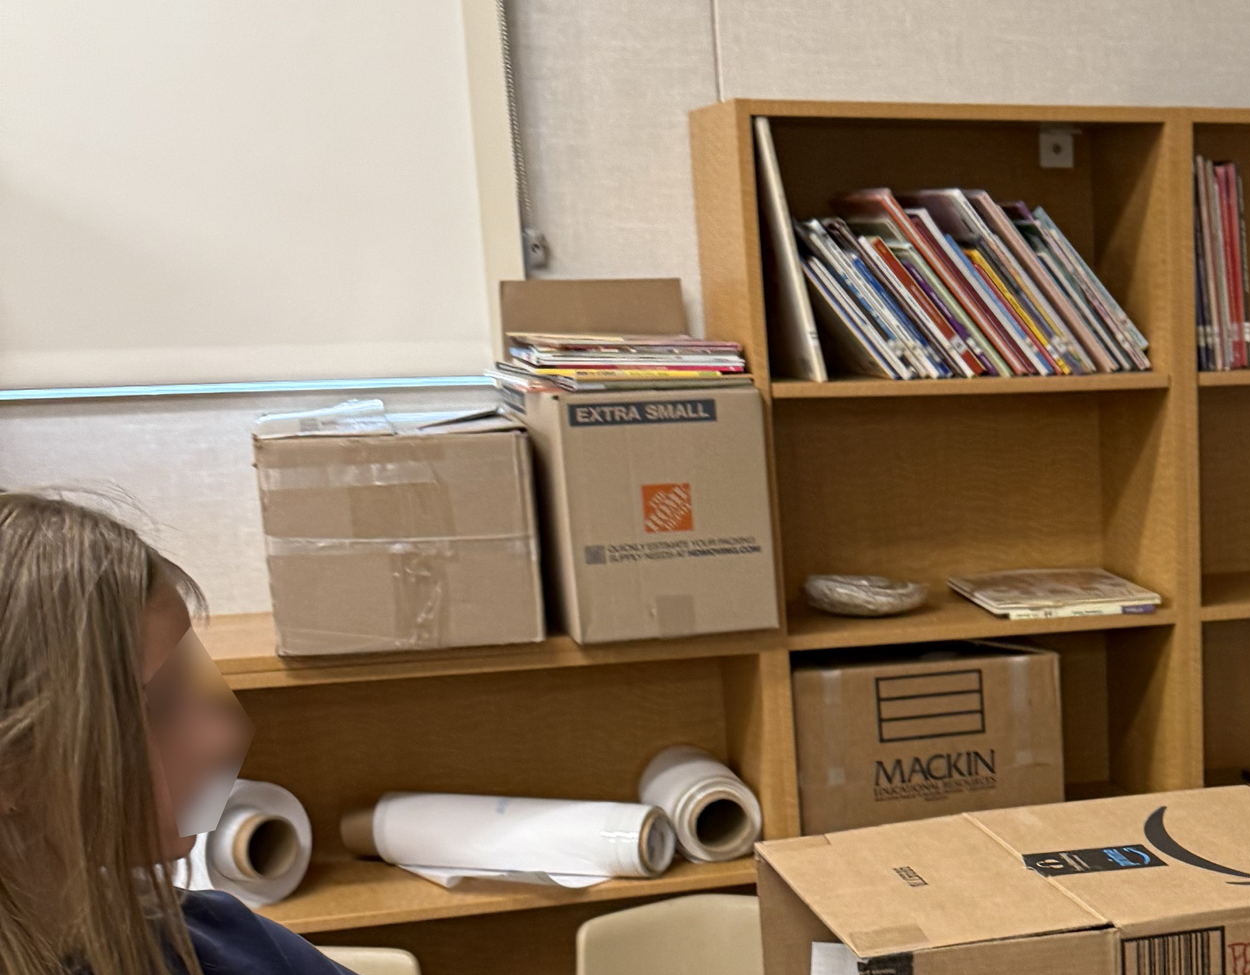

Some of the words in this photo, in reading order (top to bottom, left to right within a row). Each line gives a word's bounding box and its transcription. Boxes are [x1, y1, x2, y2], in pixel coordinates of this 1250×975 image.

[575, 405, 641, 423] EXTRA
[644, 402, 710, 421] SMALL
[874, 749, 996, 786] MACKIN
